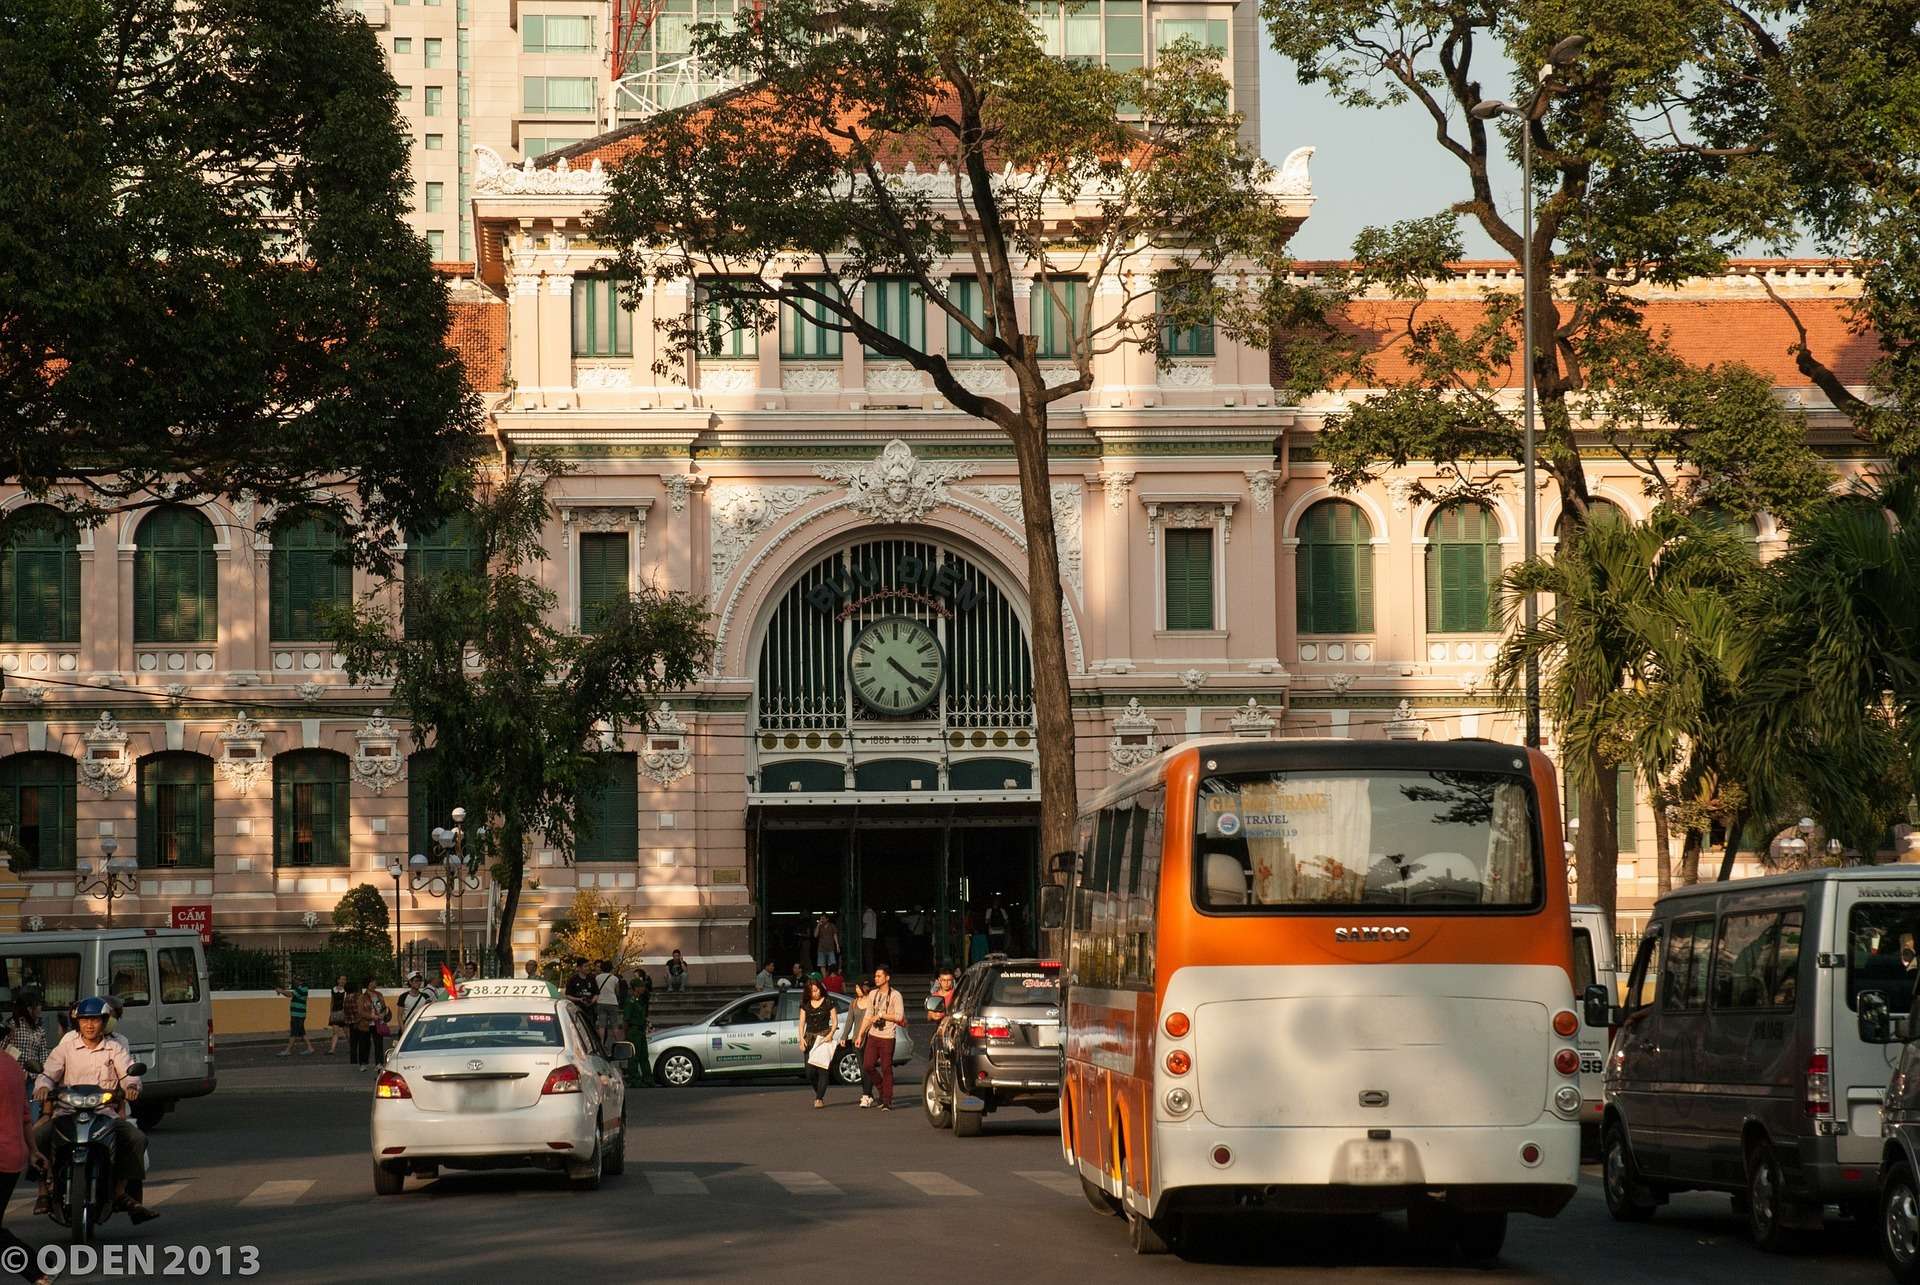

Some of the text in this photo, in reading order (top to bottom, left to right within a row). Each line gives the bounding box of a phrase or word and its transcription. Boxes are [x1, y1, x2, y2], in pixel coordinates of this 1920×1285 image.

[1245, 815, 1288, 825] TRAVEL
[178, 907, 206, 921] CẤM
[1335, 927, 1410, 942] SAMCO
[513, 986, 529, 995] 27
[531, 985, 546, 995] 27
